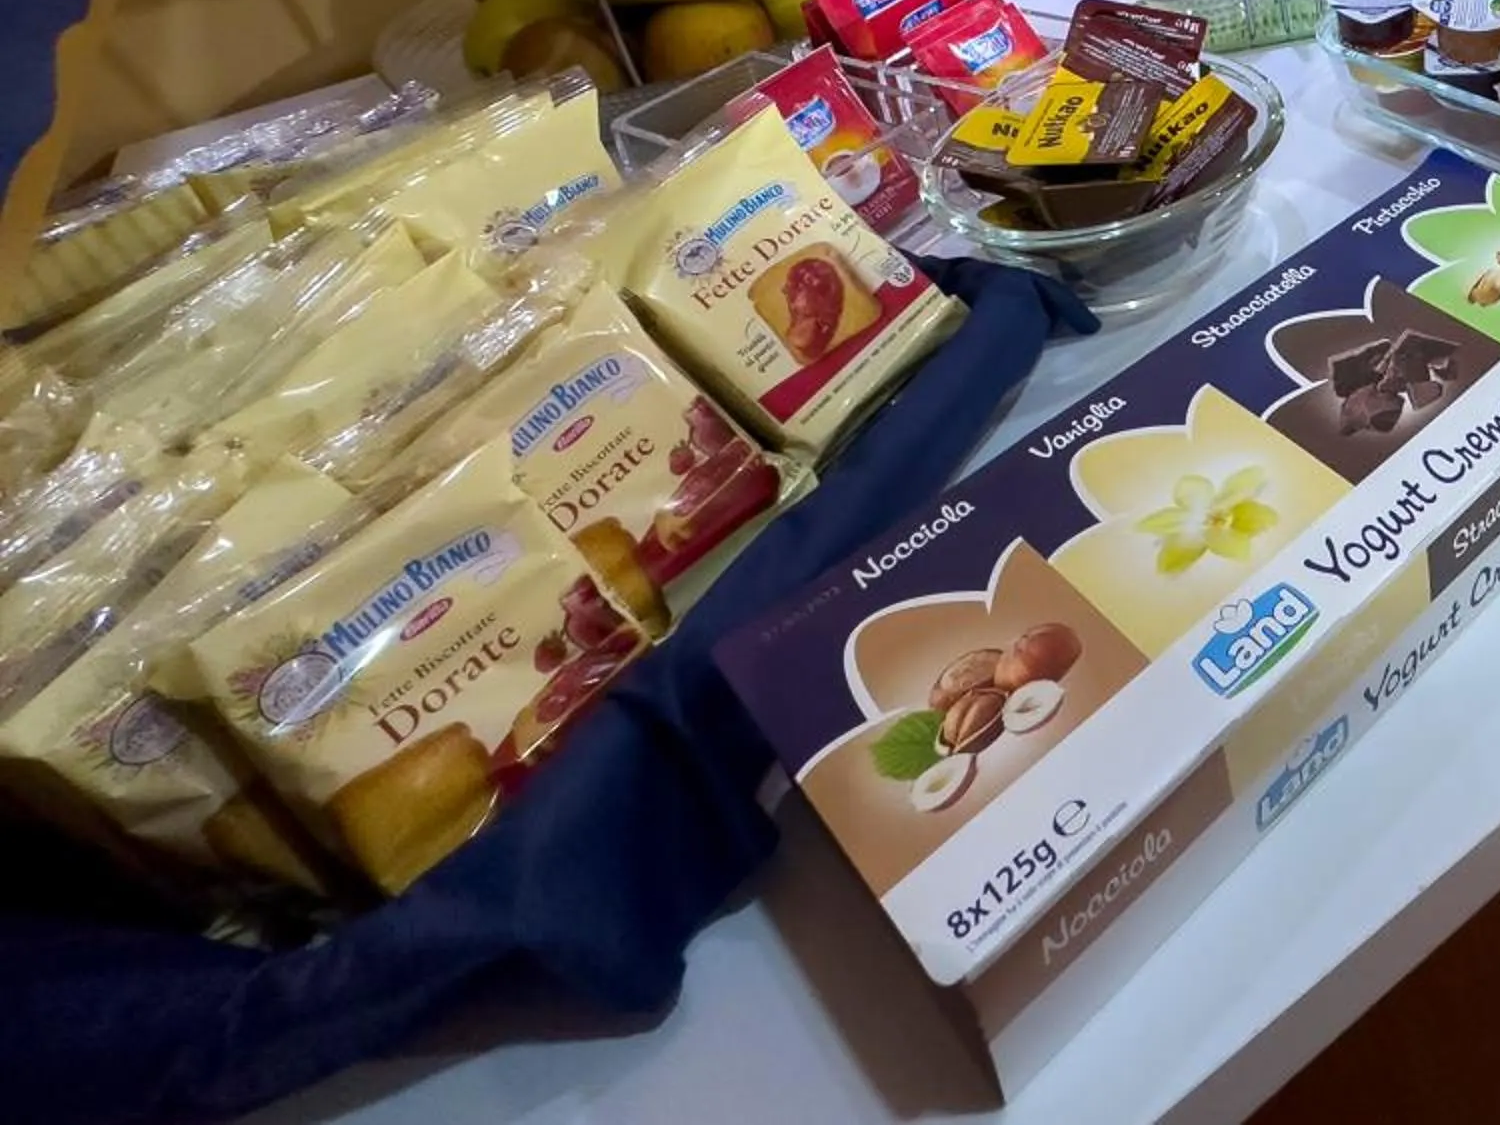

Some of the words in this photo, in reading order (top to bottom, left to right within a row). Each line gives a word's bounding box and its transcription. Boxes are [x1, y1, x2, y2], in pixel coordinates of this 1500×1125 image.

[691, 260, 757, 311] Fette
[752, 197, 834, 262] Dorate
[1351, 175, 1442, 237] Pistacchio
[1191, 260, 1318, 350] Stracciatella
[511, 401, 562, 458] ULINO
[549, 358, 622, 410] BIANCO
[1028, 395, 1128, 459] Vaniglia
[546, 437, 656, 533] Dorate
[1303, 479, 1438, 583] Yogurt
[322, 581, 415, 660] MULINO
[403, 530, 493, 592] BIANCO
[852, 500, 976, 590] Nocciola
[374, 624, 522, 745] Dorate
[1200, 588, 1309, 689] Land
[1363, 602, 1461, 712] Yogurt
[946, 838, 1058, 939] 8x125g
[1041, 828, 1172, 966] Nocciola
